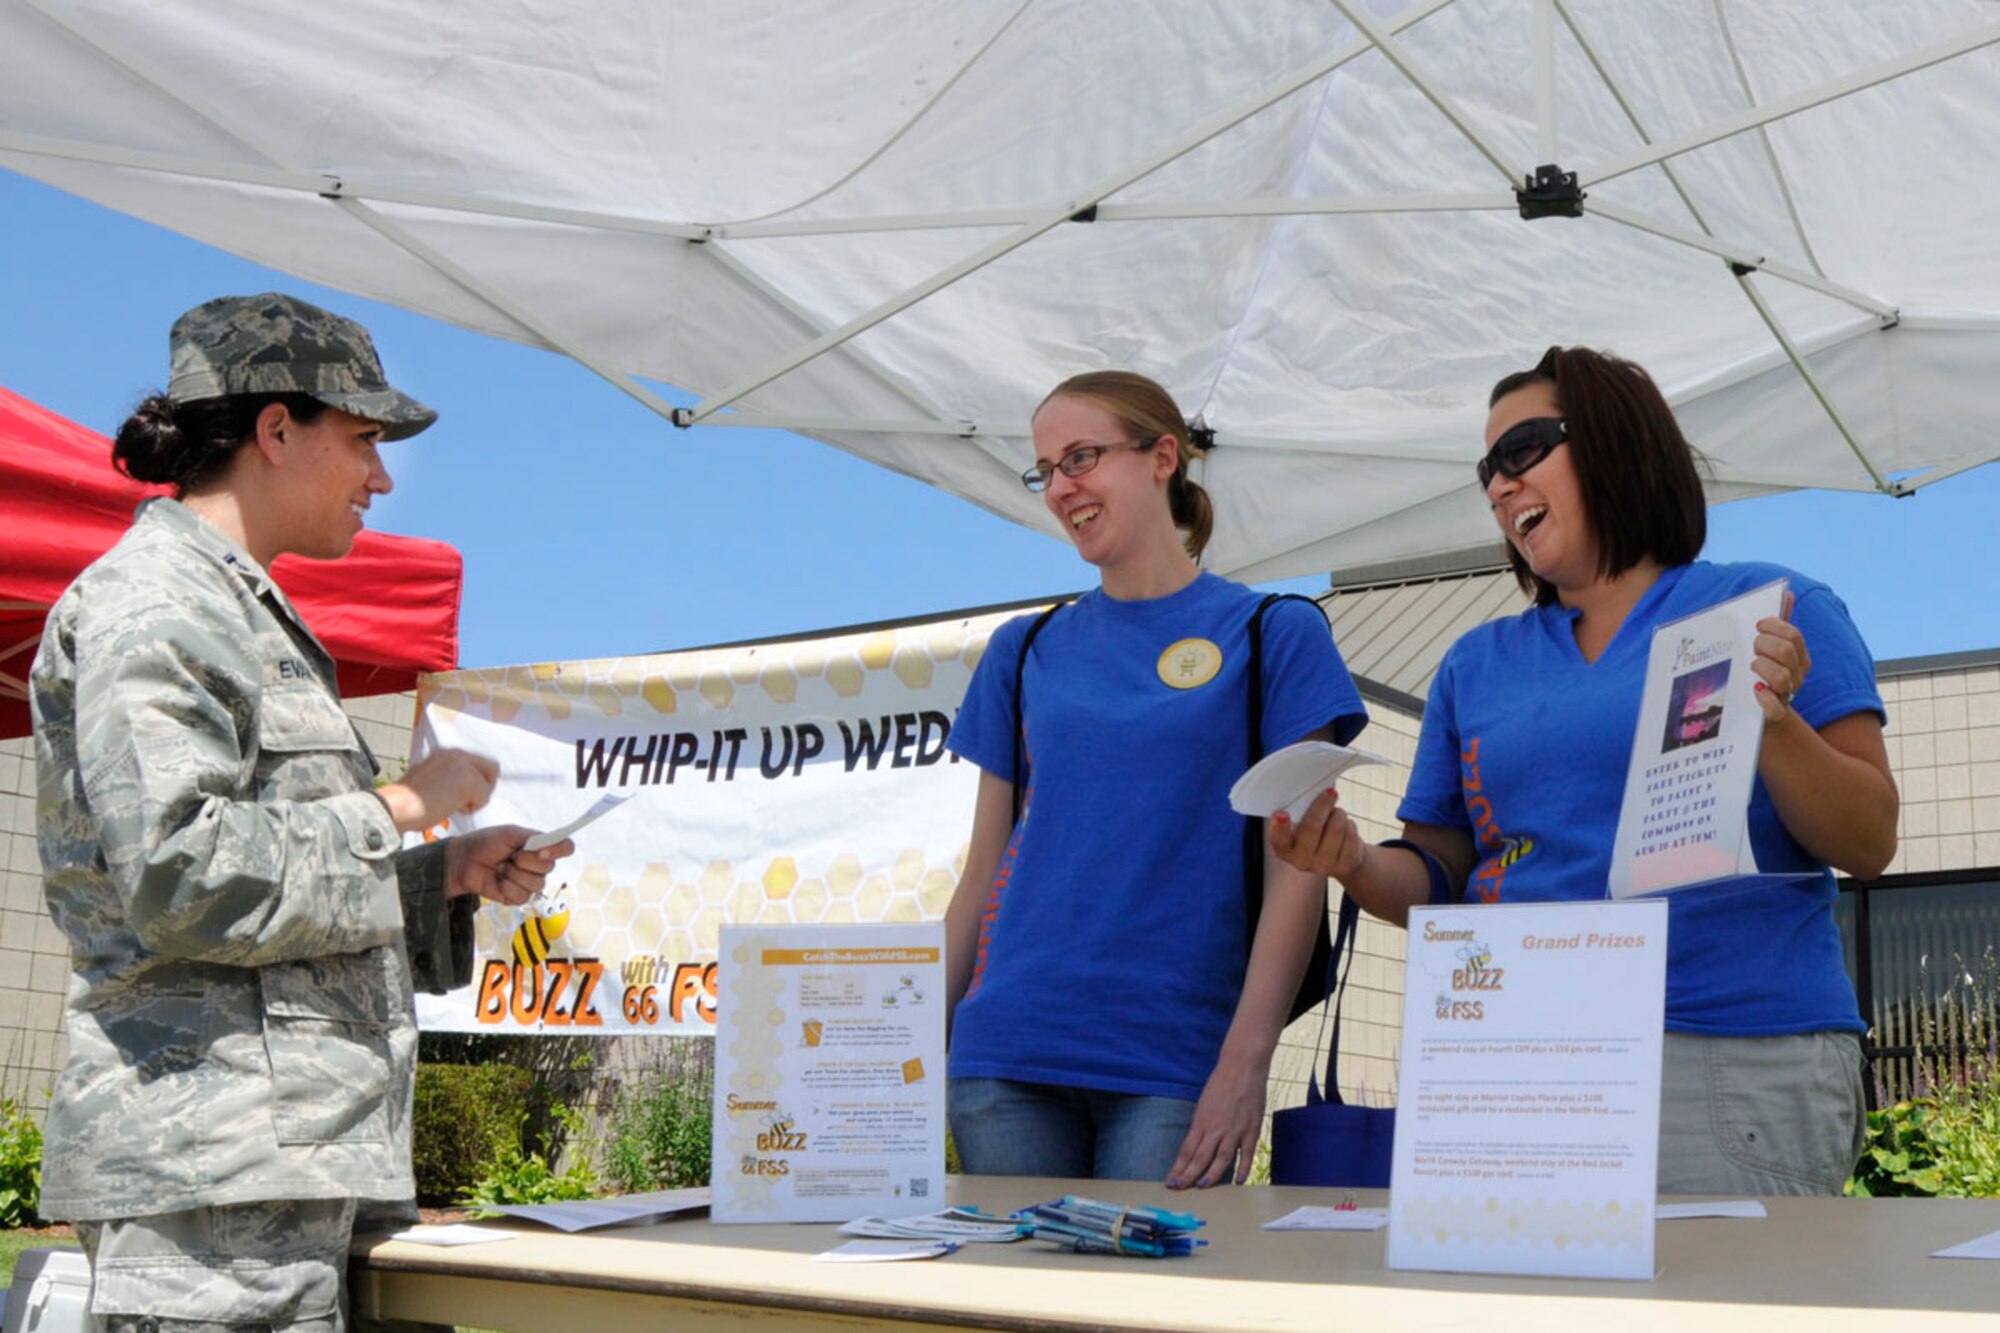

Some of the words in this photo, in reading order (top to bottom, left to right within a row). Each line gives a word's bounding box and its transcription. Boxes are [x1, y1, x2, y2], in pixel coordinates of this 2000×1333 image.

[576, 728, 747, 789] WHIP-IT
[760, 723, 824, 779] UP
[837, 708, 959, 772] WED
[1646, 761, 1678, 778] ENTER
[1685, 756, 1699, 766] TO
[1703, 748, 1725, 760] WIN
[1647, 778, 1673, 793] FREE
[1678, 763, 1726, 783] TICKETS
[1651, 796, 1664, 807] TO
[1668, 785, 1701, 802] PAINT
[1644, 807, 1678, 824] PARTY
[1694, 797, 1715, 811] THE
[1698, 815, 1711, 826] ON
[1673, 837, 1686, 848] AT
[1424, 921, 1475, 942] Summer
[1522, 934, 1581, 950] Grand
[1586, 933, 1646, 948] Prizes
[621, 955, 670, 984] with
[1452, 968, 1504, 991] BUZZ
[476, 957, 604, 1026] BUZZ
[623, 986, 660, 1025] 66
[1451, 1001, 1484, 1021] FSS
[726, 1092, 778, 1112] Summer
[757, 1133, 808, 1151] BUZZ
[758, 1159, 789, 1176] FSS
